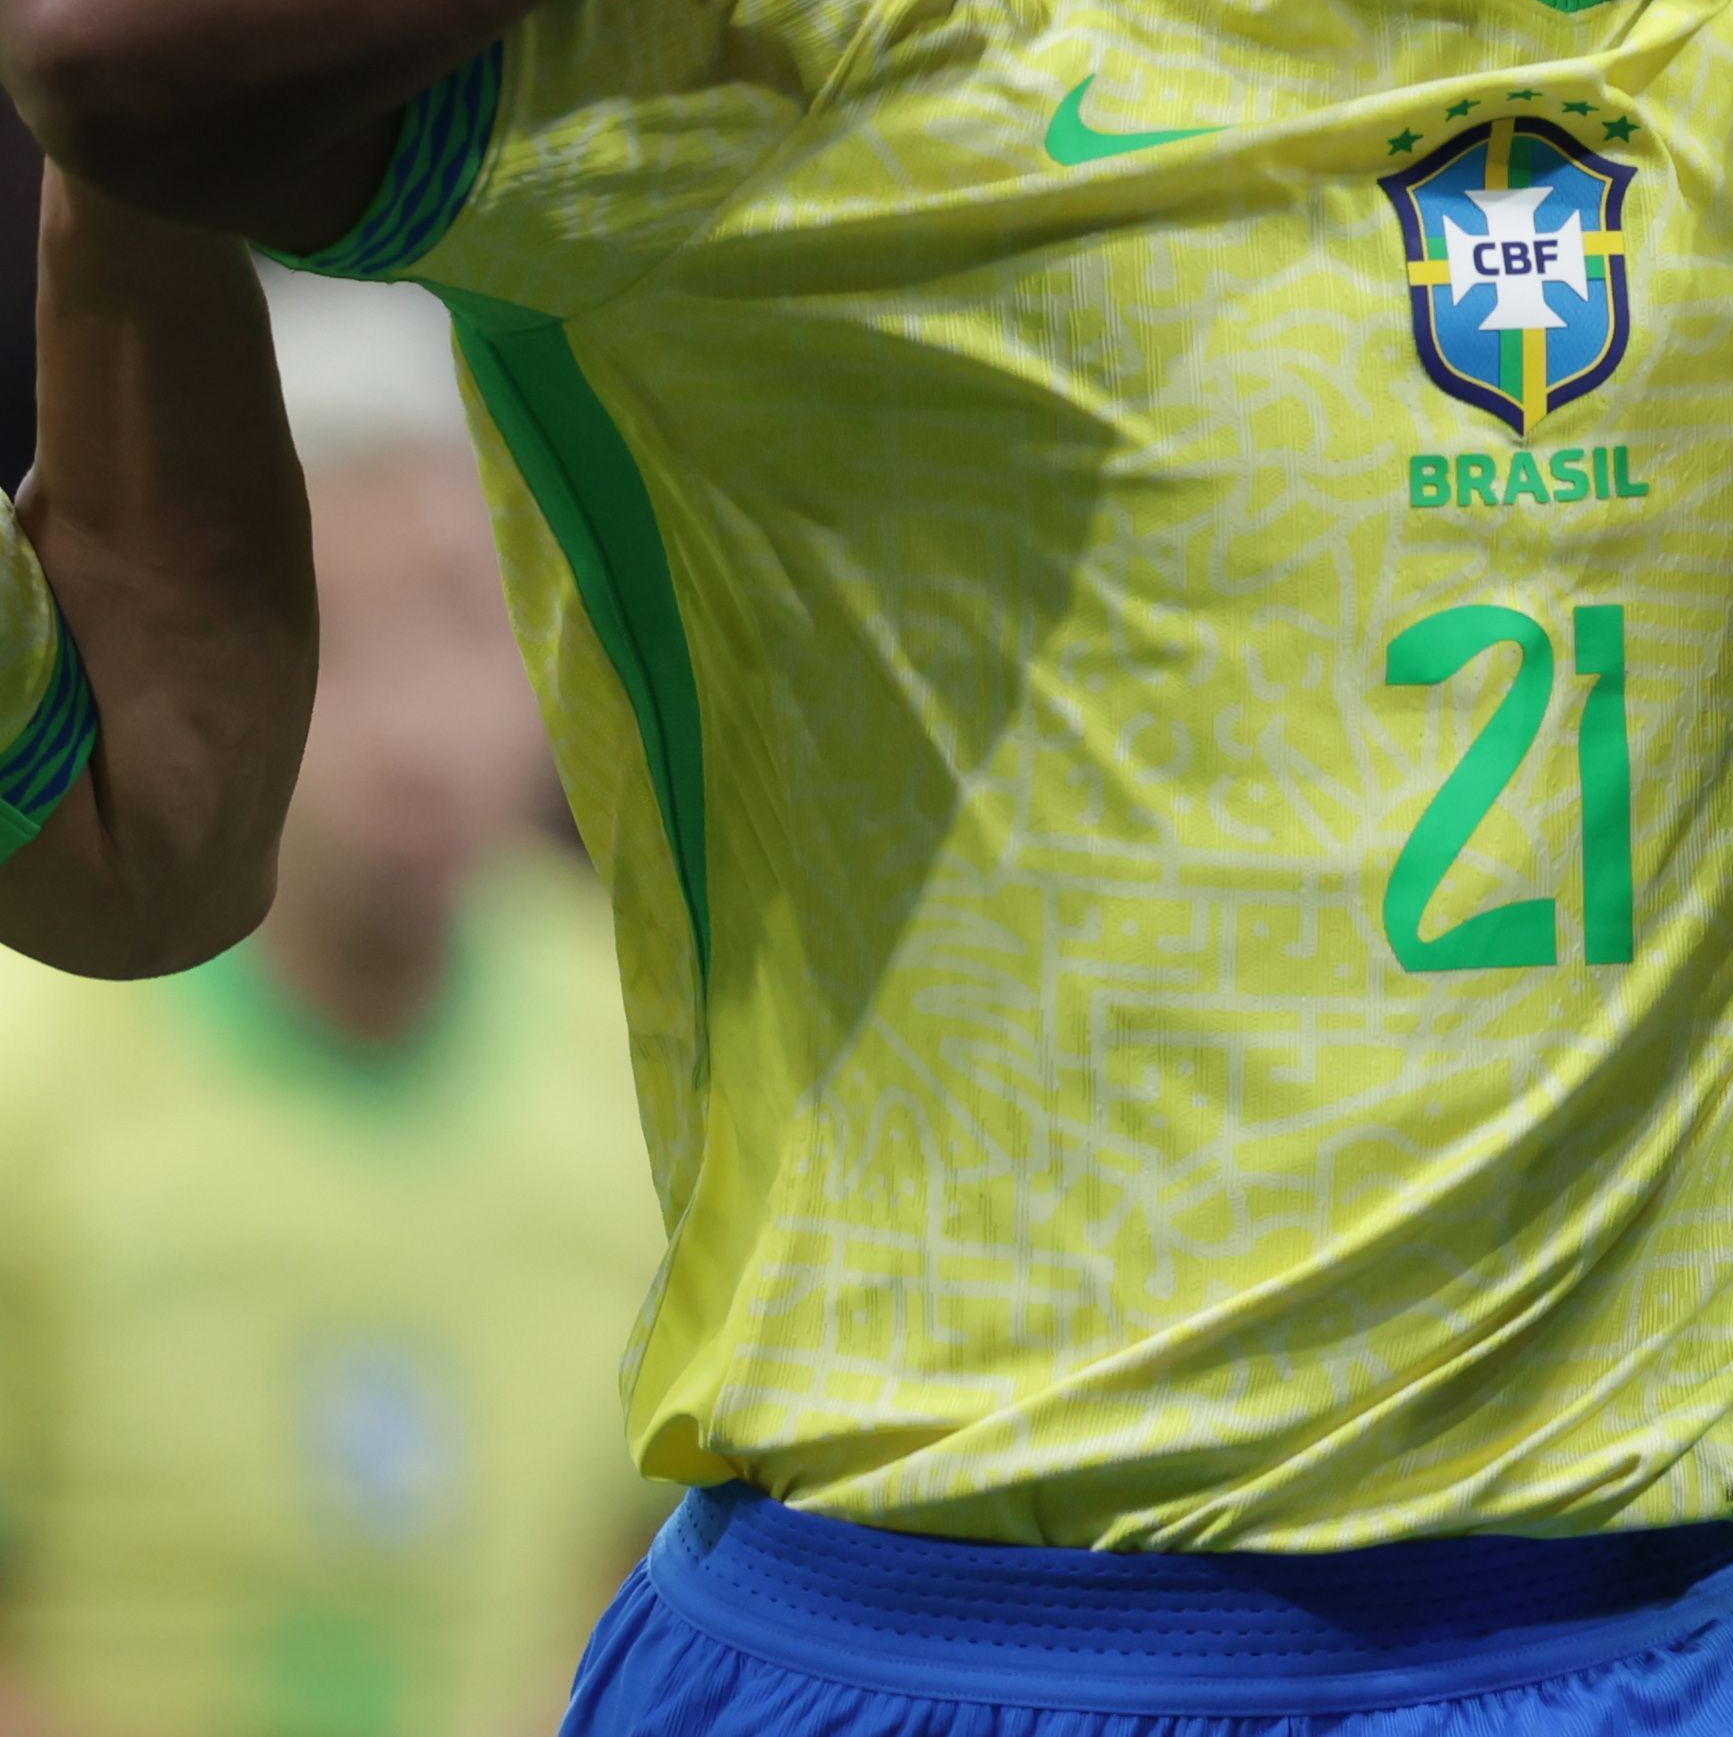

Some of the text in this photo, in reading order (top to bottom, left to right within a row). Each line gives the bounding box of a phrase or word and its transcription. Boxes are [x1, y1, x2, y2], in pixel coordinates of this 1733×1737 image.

[1472, 239, 1559, 276] CBF
[1408, 445, 1650, 508] BRASIL
[1382, 604, 1634, 973] 21
